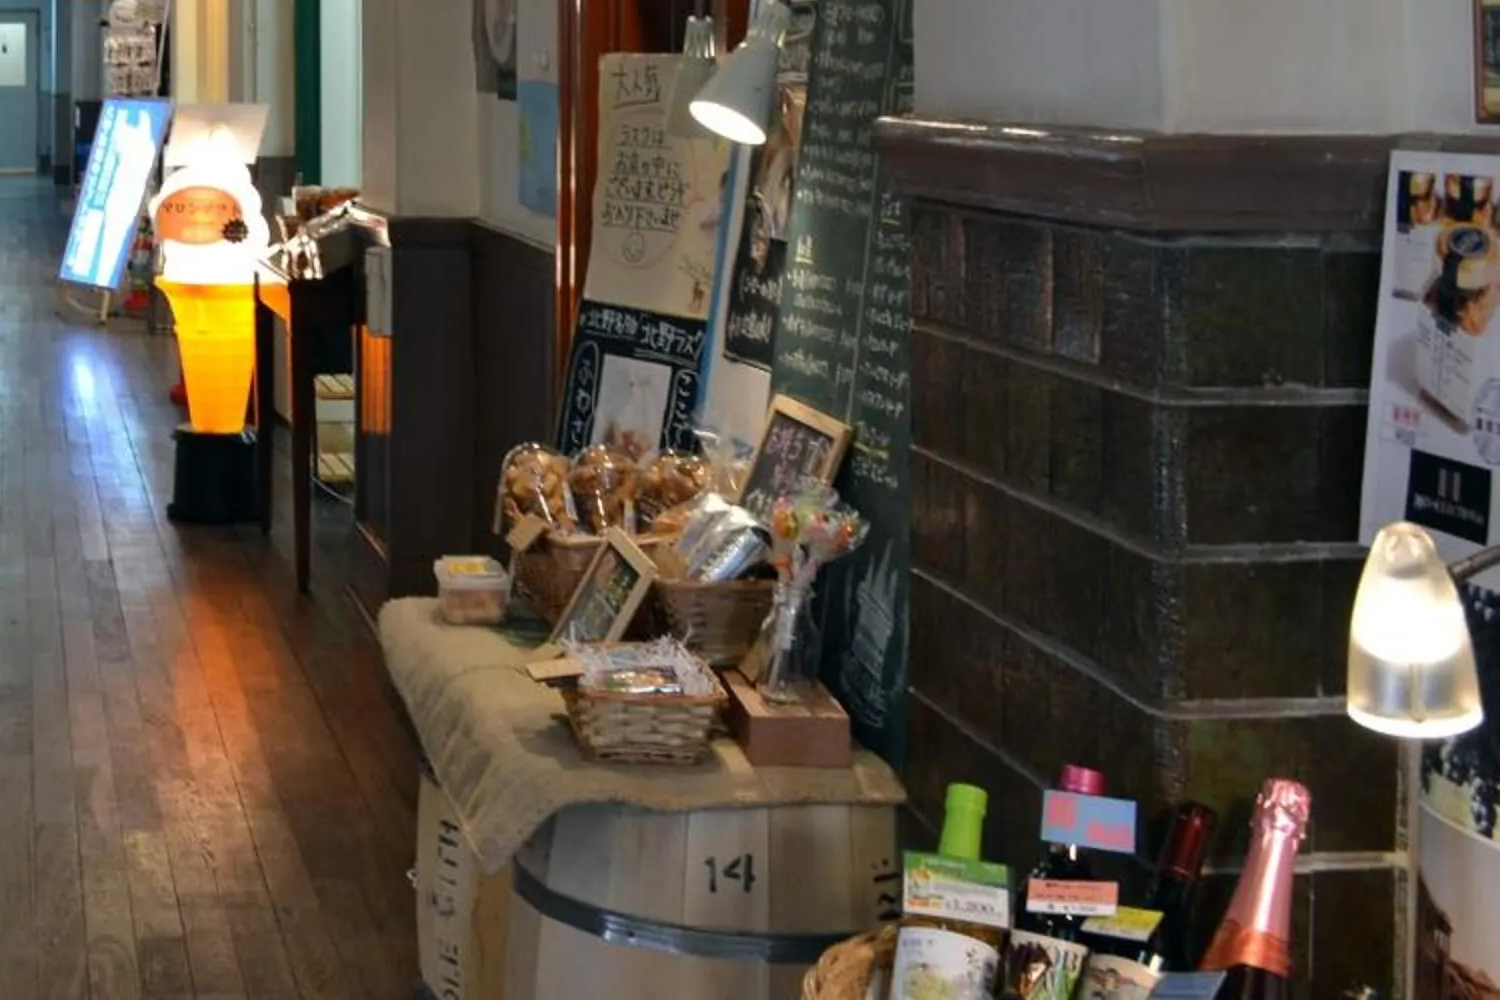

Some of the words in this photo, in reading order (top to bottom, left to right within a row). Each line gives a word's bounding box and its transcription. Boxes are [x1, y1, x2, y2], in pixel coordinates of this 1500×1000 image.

[611, 62, 661, 101] 大人気
[703, 852, 756, 895] 14
